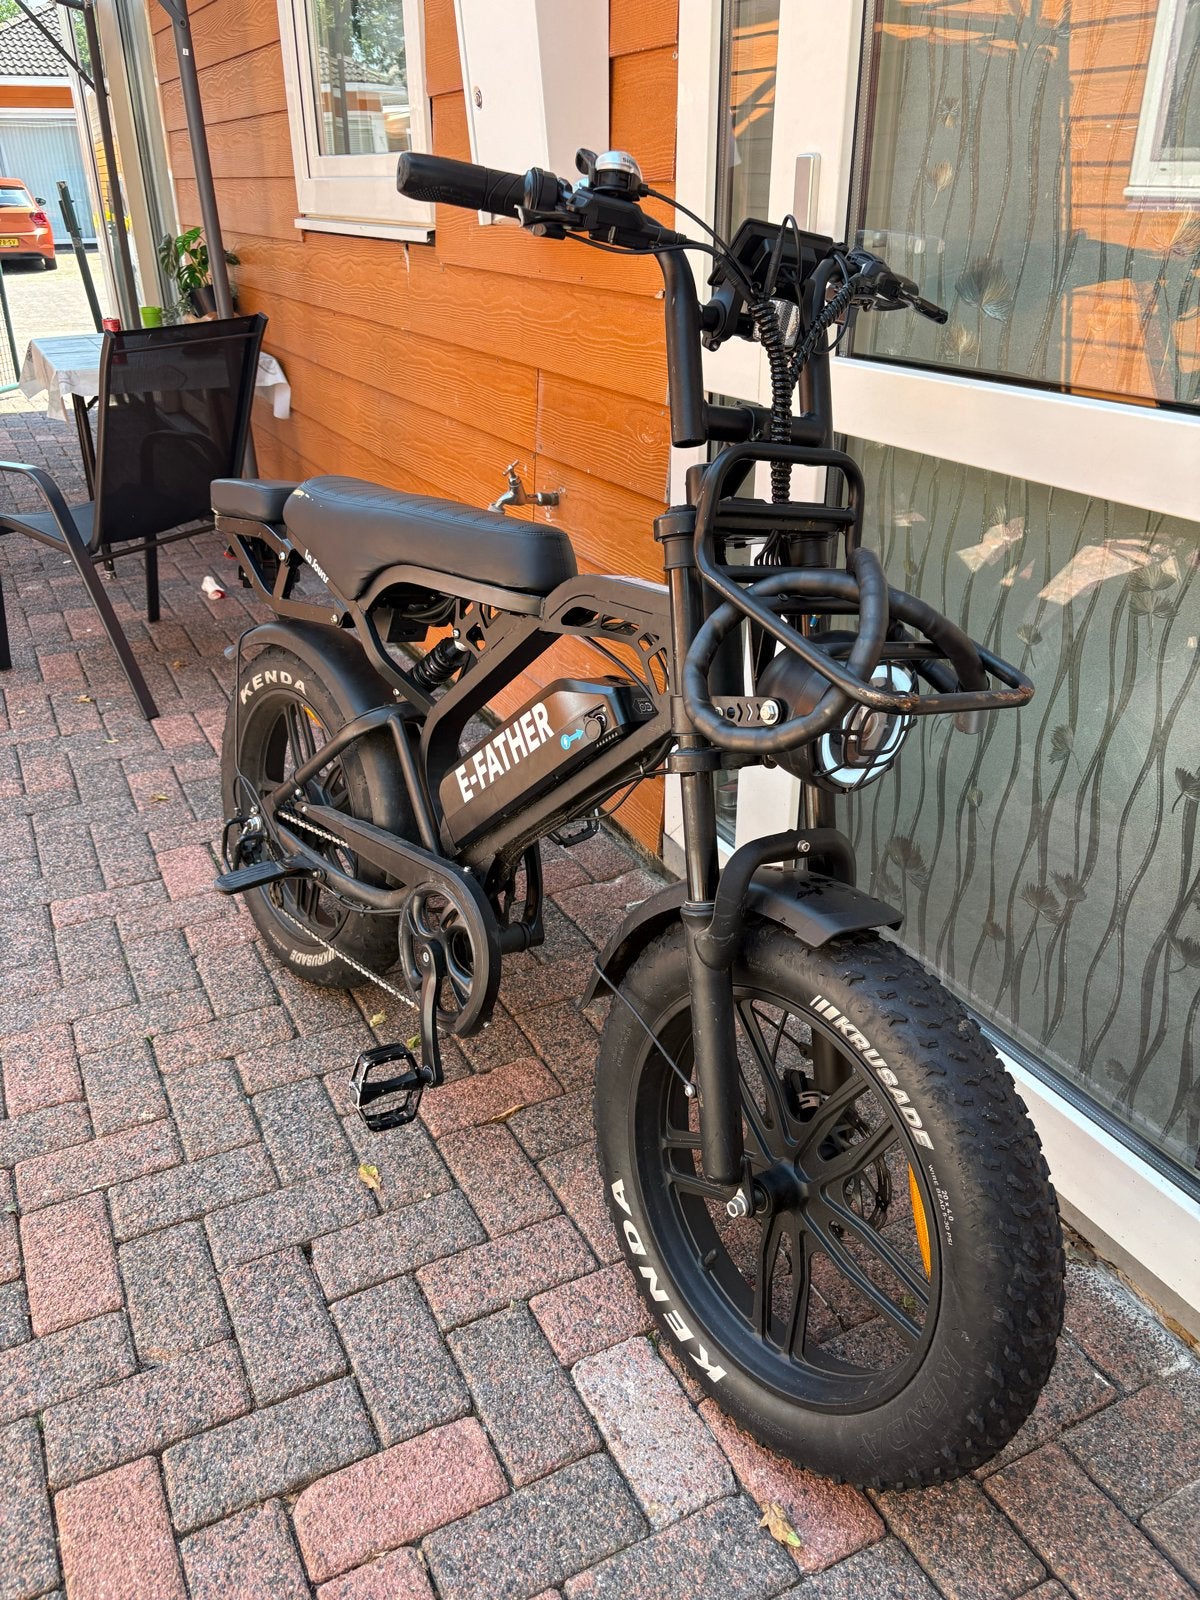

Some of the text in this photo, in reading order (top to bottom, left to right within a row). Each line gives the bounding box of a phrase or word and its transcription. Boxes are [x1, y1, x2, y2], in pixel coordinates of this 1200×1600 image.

[240, 670, 307, 705] KENDA
[454, 702, 554, 803] E-FATHER
[289, 949, 328, 967] KRUSADE
[832, 1015, 935, 1151] KRUSADE
[928, 1164, 939, 1186] WIRE
[935, 1188, 945, 1210] BEAD
[941, 1190, 949, 1200] 20
[946, 1208, 954, 1222] 4.0
[611, 1179, 727, 1383] KENDA
